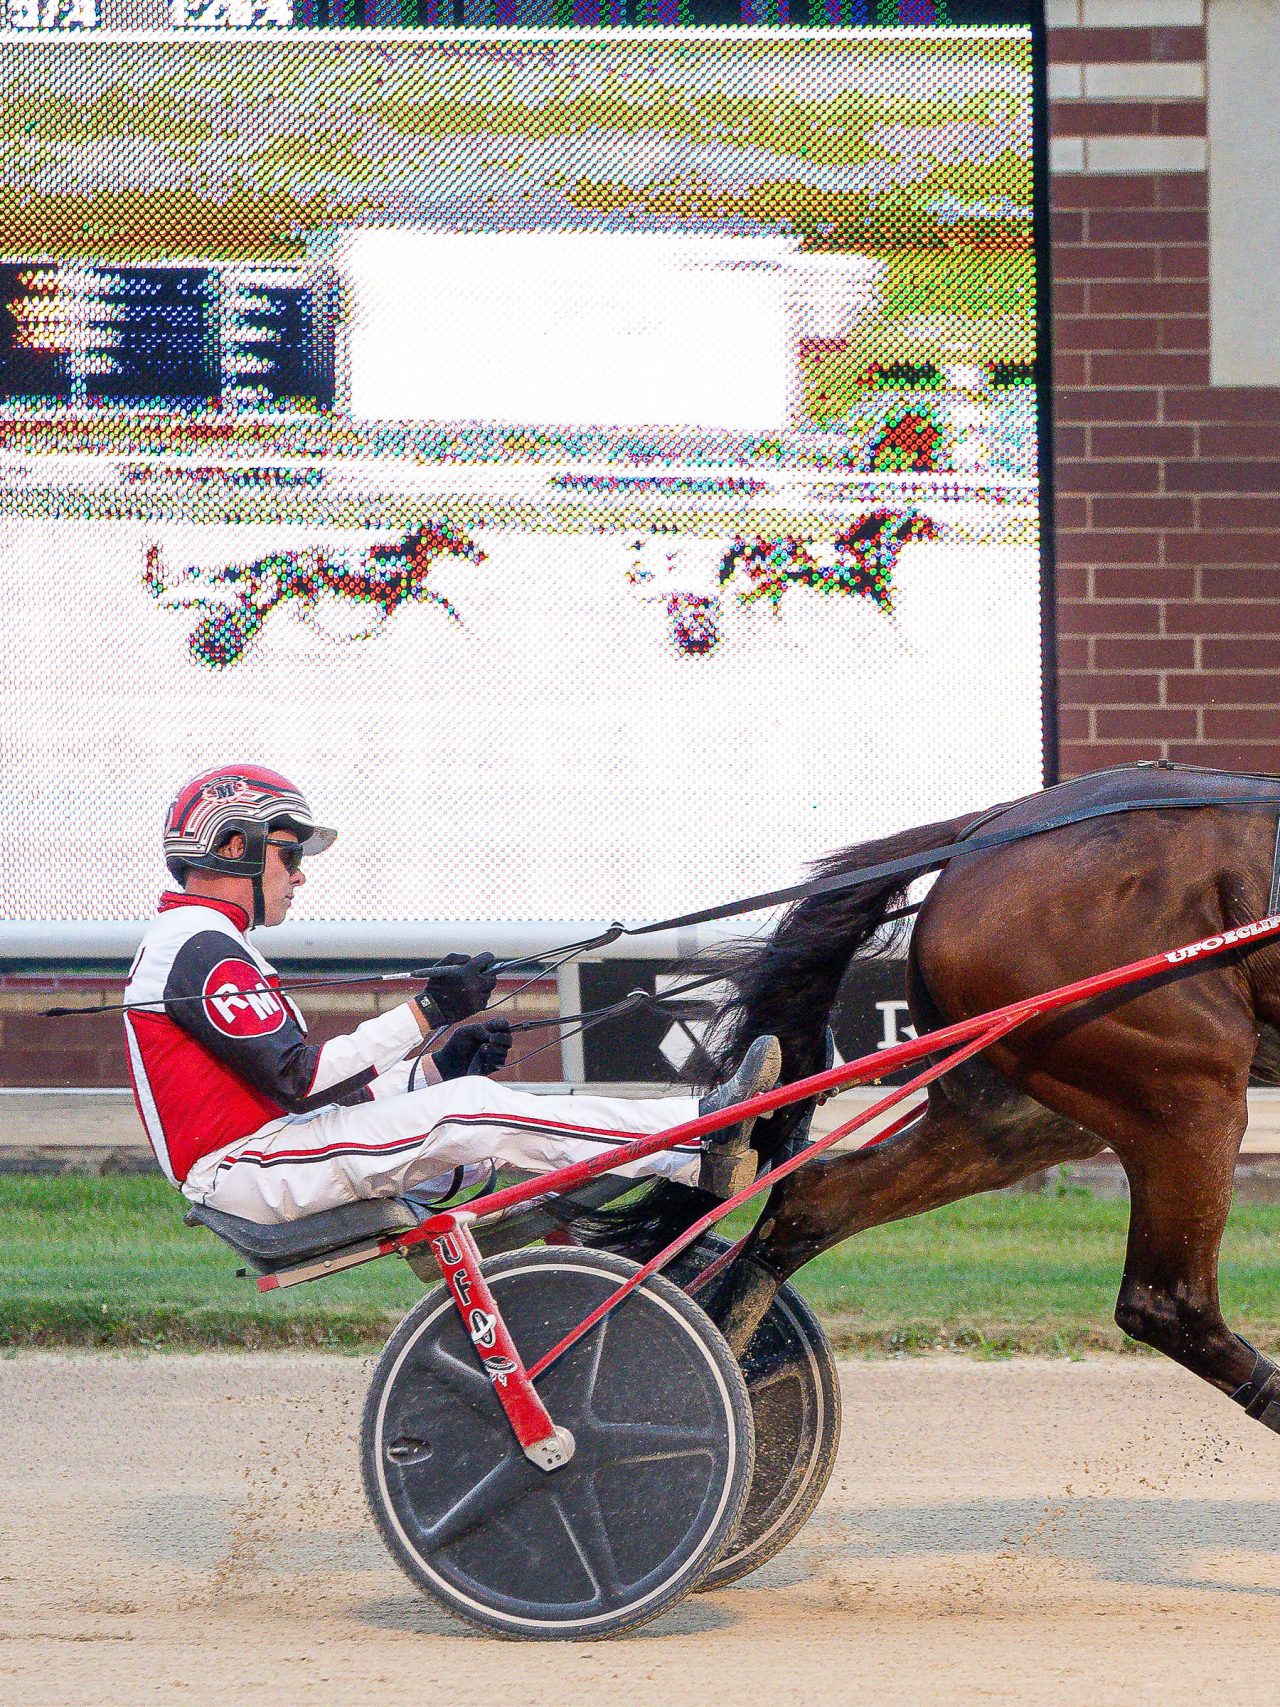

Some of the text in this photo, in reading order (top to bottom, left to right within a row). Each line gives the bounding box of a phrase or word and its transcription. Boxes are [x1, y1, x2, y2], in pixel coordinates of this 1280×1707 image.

[1164, 936, 1223, 963] UFO
[210, 982, 280, 1024] RM
[432, 1233, 497, 1349] UFO
